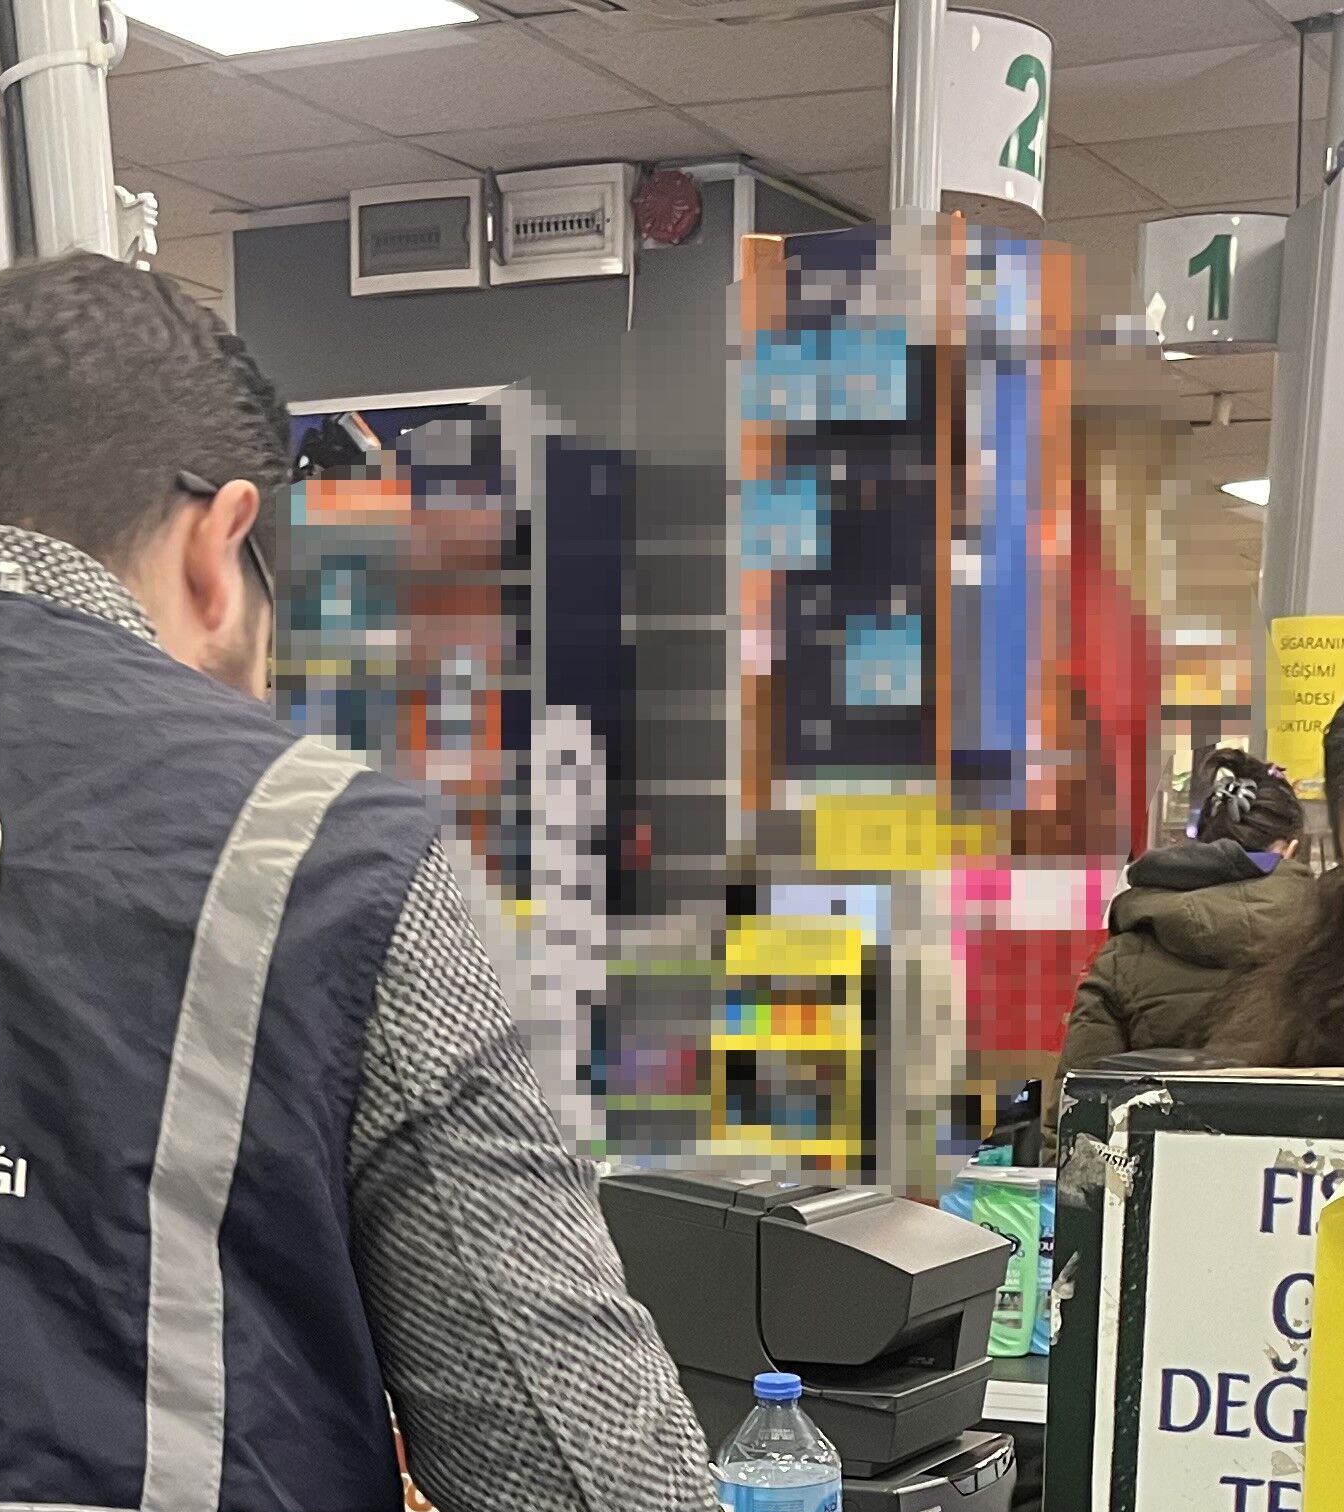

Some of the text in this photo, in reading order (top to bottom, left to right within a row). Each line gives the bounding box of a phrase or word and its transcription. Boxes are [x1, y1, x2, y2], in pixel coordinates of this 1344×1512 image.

[999, 54, 1046, 180] 2
[1188, 234, 1233, 322] 1
[1158, 1357, 1309, 1444] DEĞ
